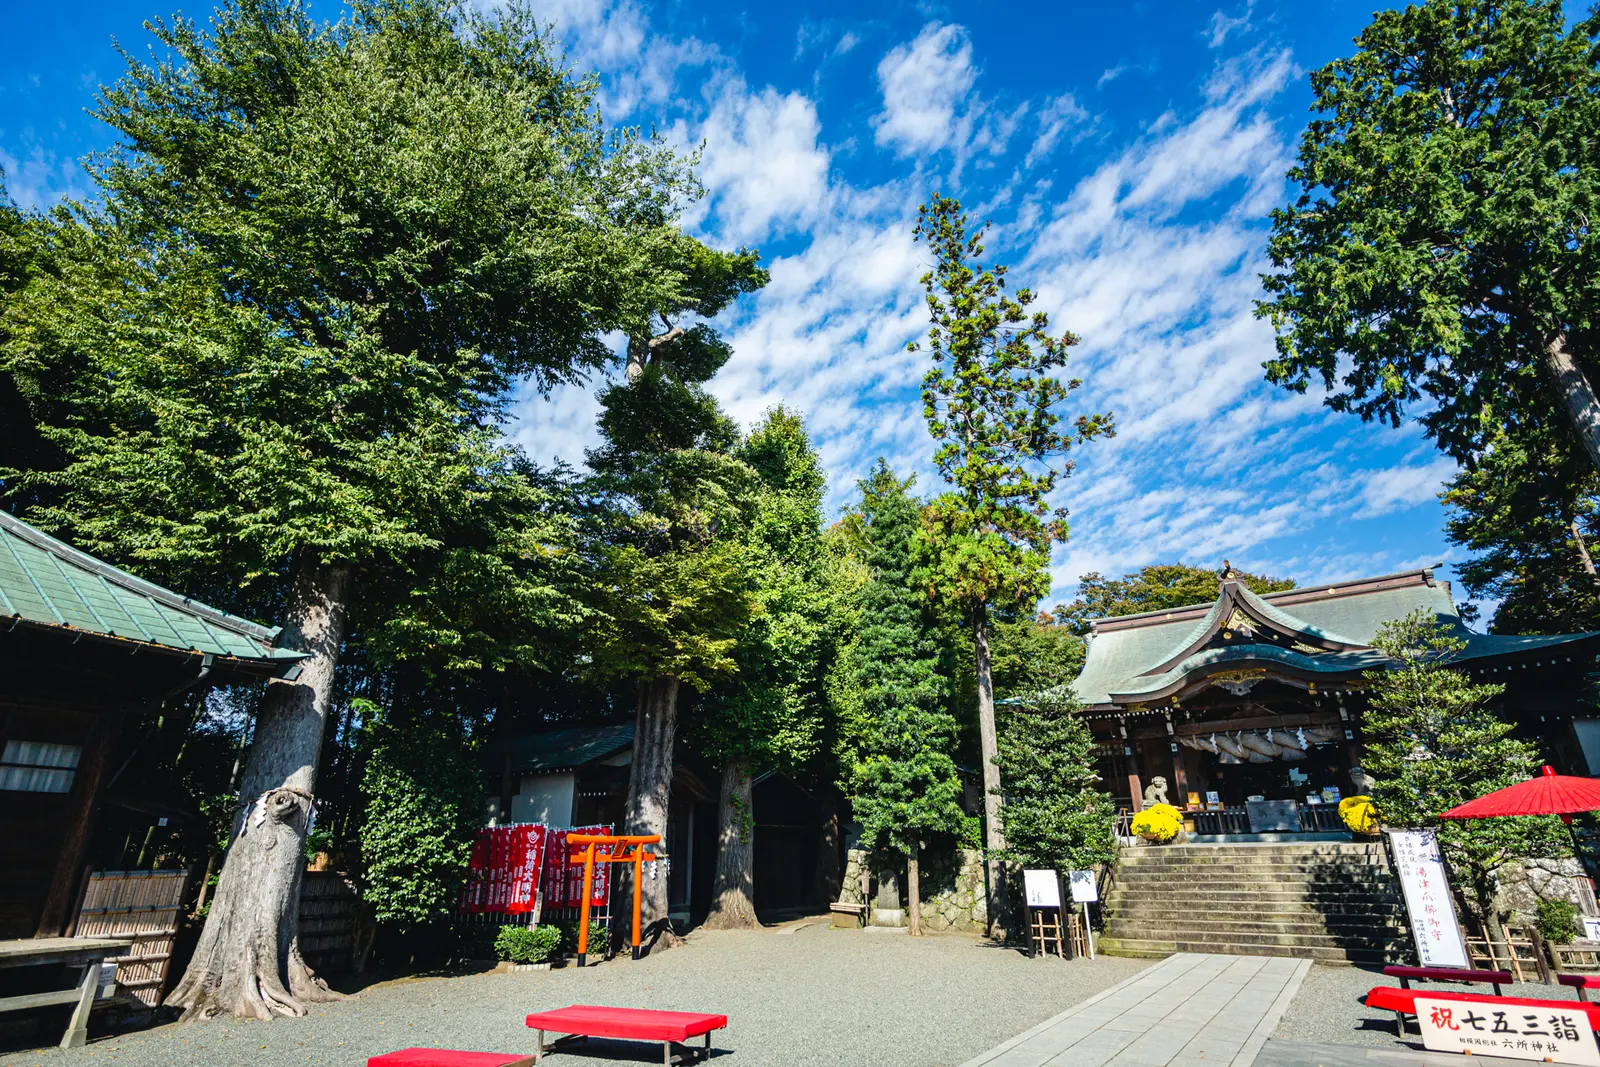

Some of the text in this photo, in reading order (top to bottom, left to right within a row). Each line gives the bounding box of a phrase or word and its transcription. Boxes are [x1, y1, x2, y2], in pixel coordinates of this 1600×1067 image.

[519, 849, 537, 905] 稲荷大明神
[1501, 1038, 1560, 1053] 六所神社
